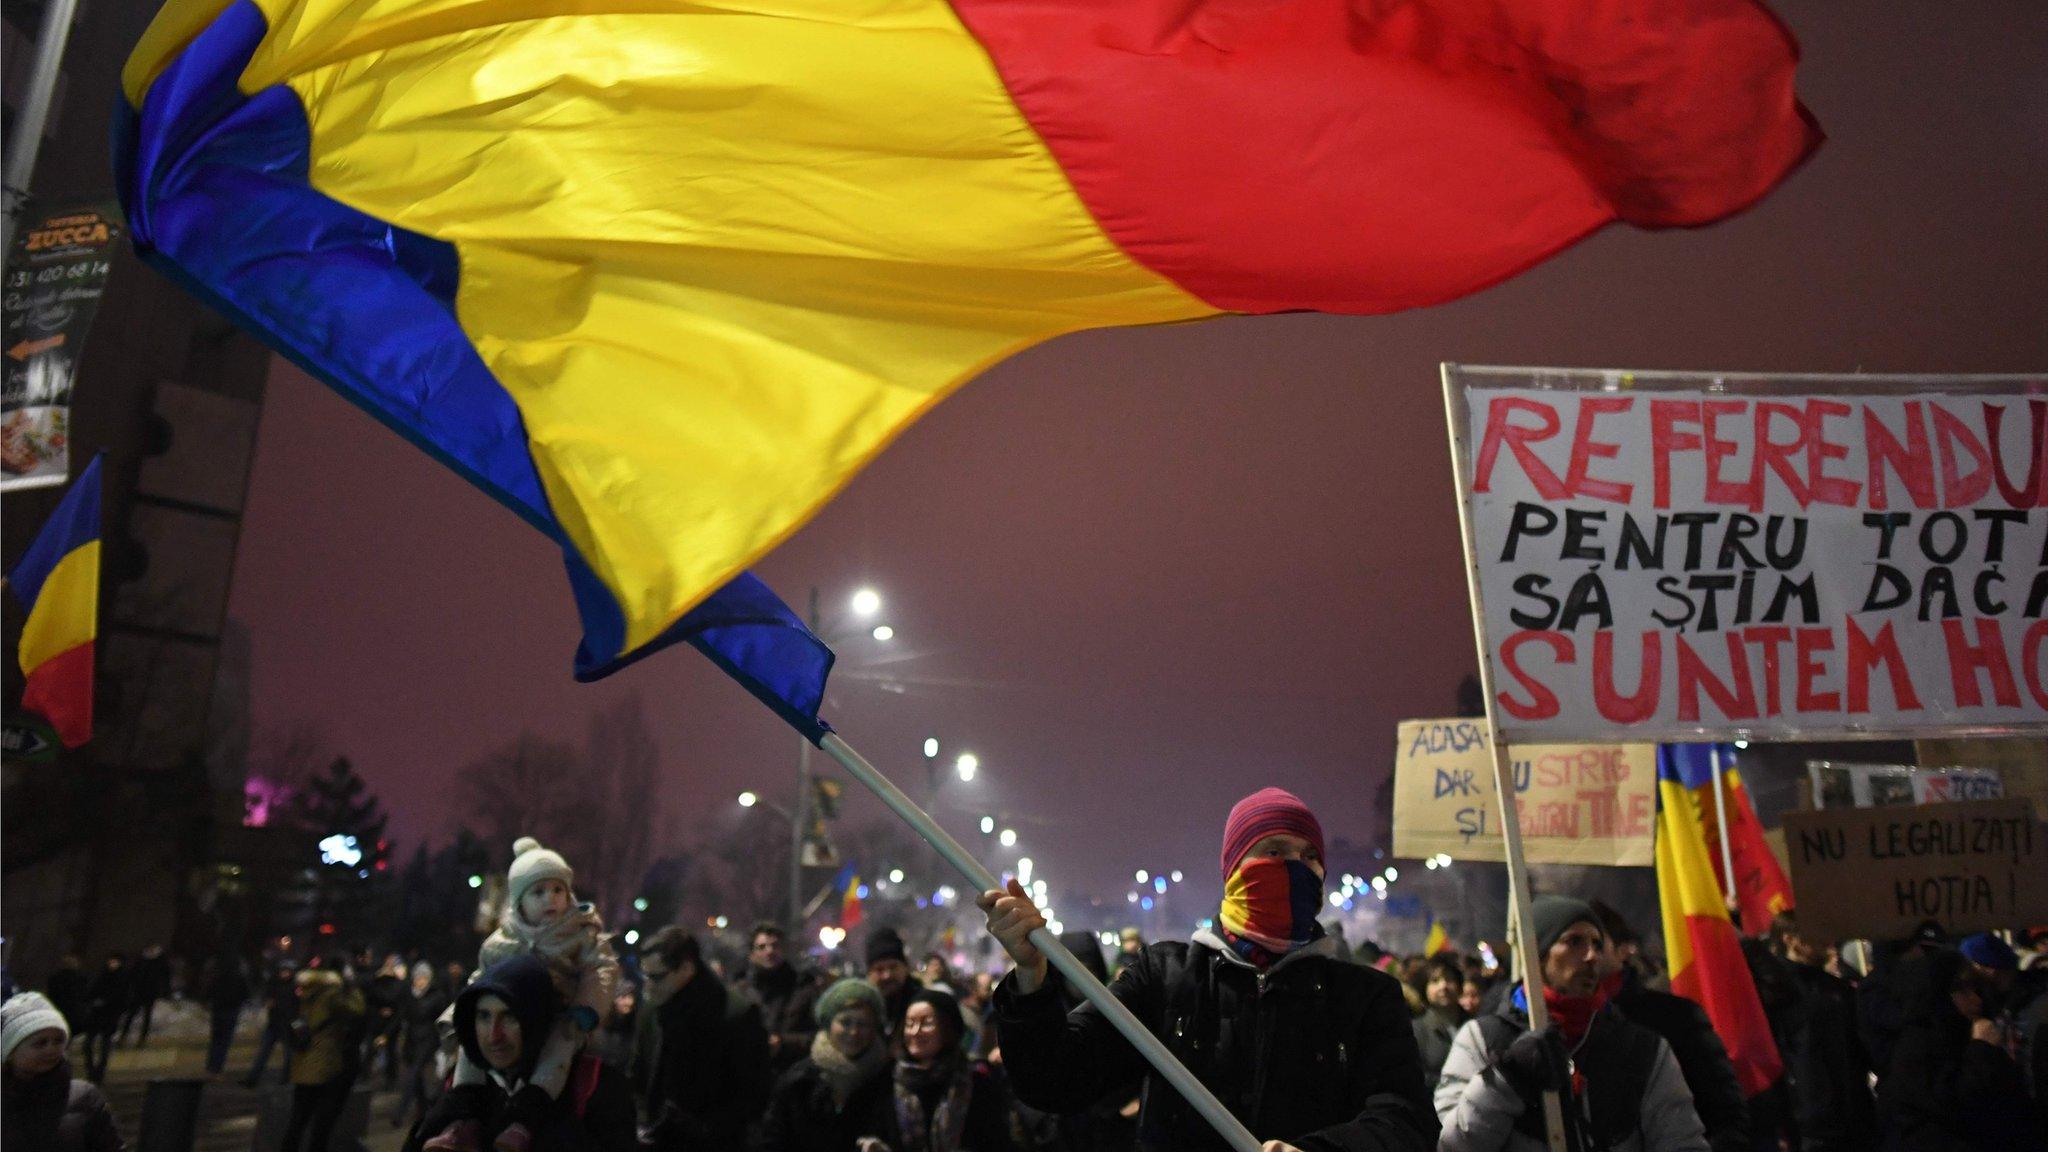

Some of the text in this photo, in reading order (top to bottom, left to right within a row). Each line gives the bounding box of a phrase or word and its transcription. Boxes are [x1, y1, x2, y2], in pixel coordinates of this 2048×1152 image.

[25, 222, 109, 251] ZUCCA
[1473, 397, 2048, 513] REFERENDU
[1500, 502, 1807, 571] PENTRU
[1498, 614, 1923, 724] SUNTEM
[1434, 749, 1631, 799] DAR U STRIG
[1801, 827, 1846, 864] NU
